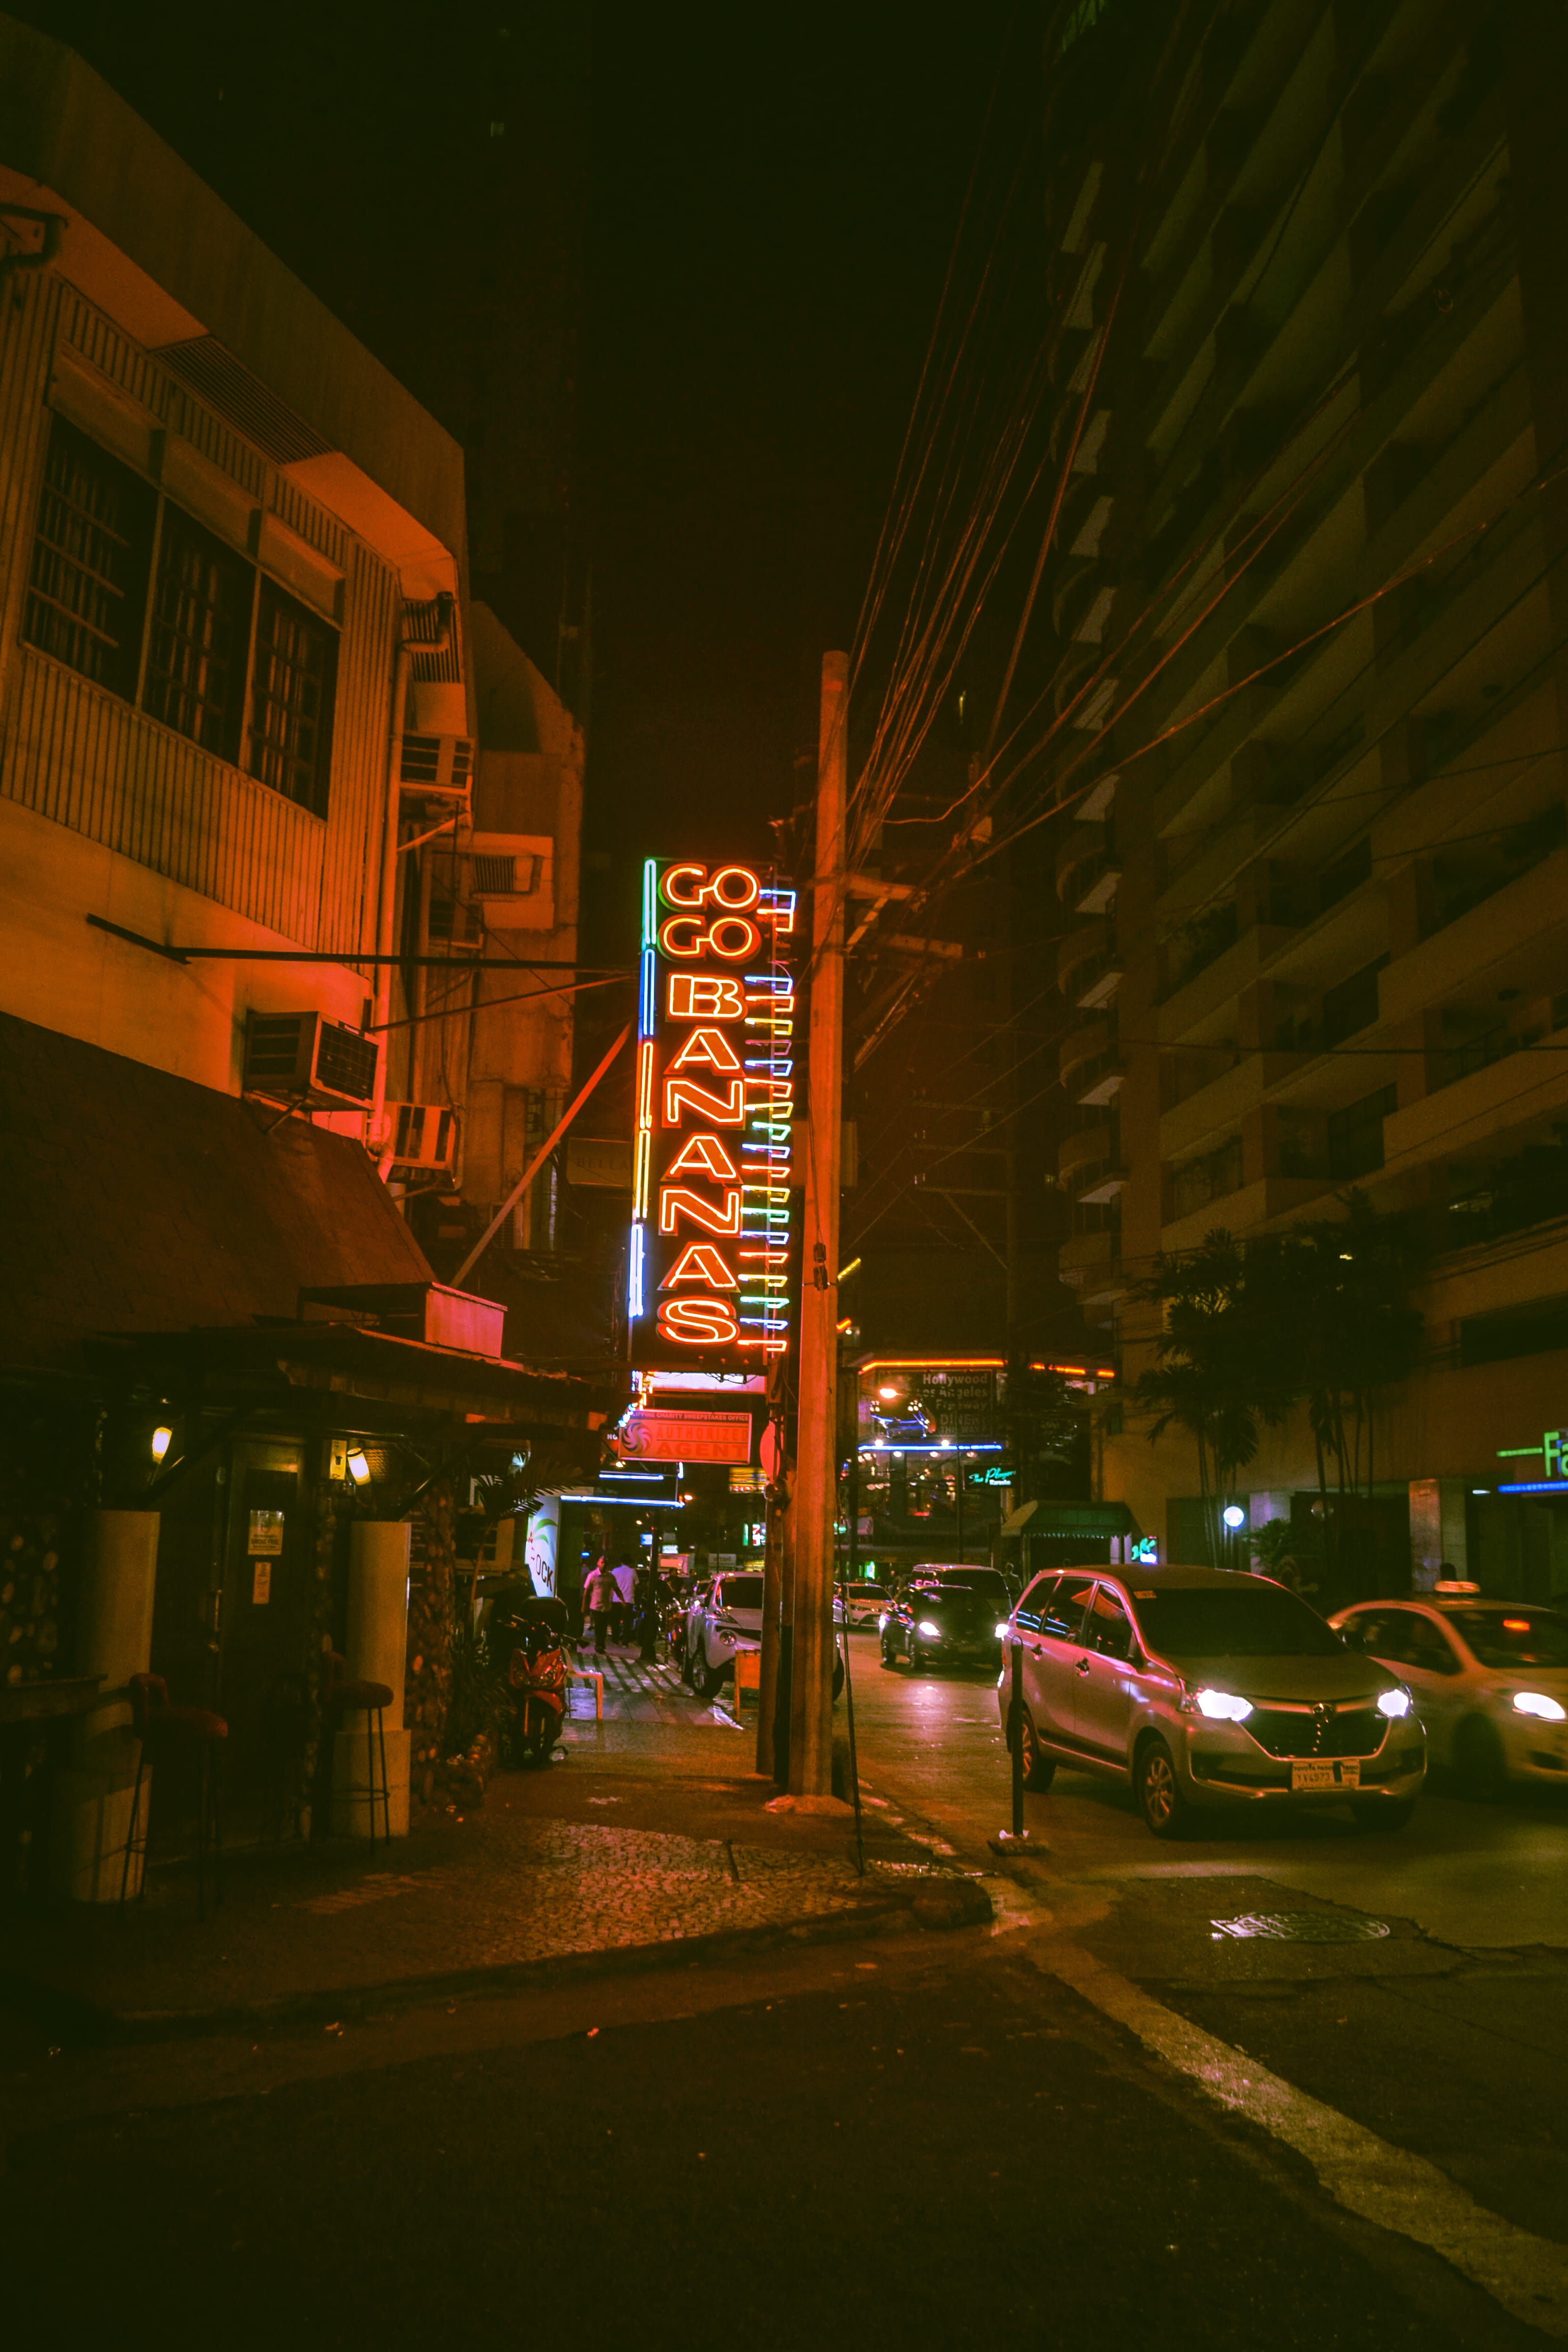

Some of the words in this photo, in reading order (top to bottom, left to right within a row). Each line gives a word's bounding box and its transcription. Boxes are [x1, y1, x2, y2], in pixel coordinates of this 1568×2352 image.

[659, 863, 761, 911] GO
[658, 914, 761, 961] GO
[657, 973, 748, 1345] BANANAS
[923, 1373, 988, 1387] Hollywood
[656, 1427, 748, 1441] AUTHORIZED
[656, 1442, 747, 1458] AGENT
